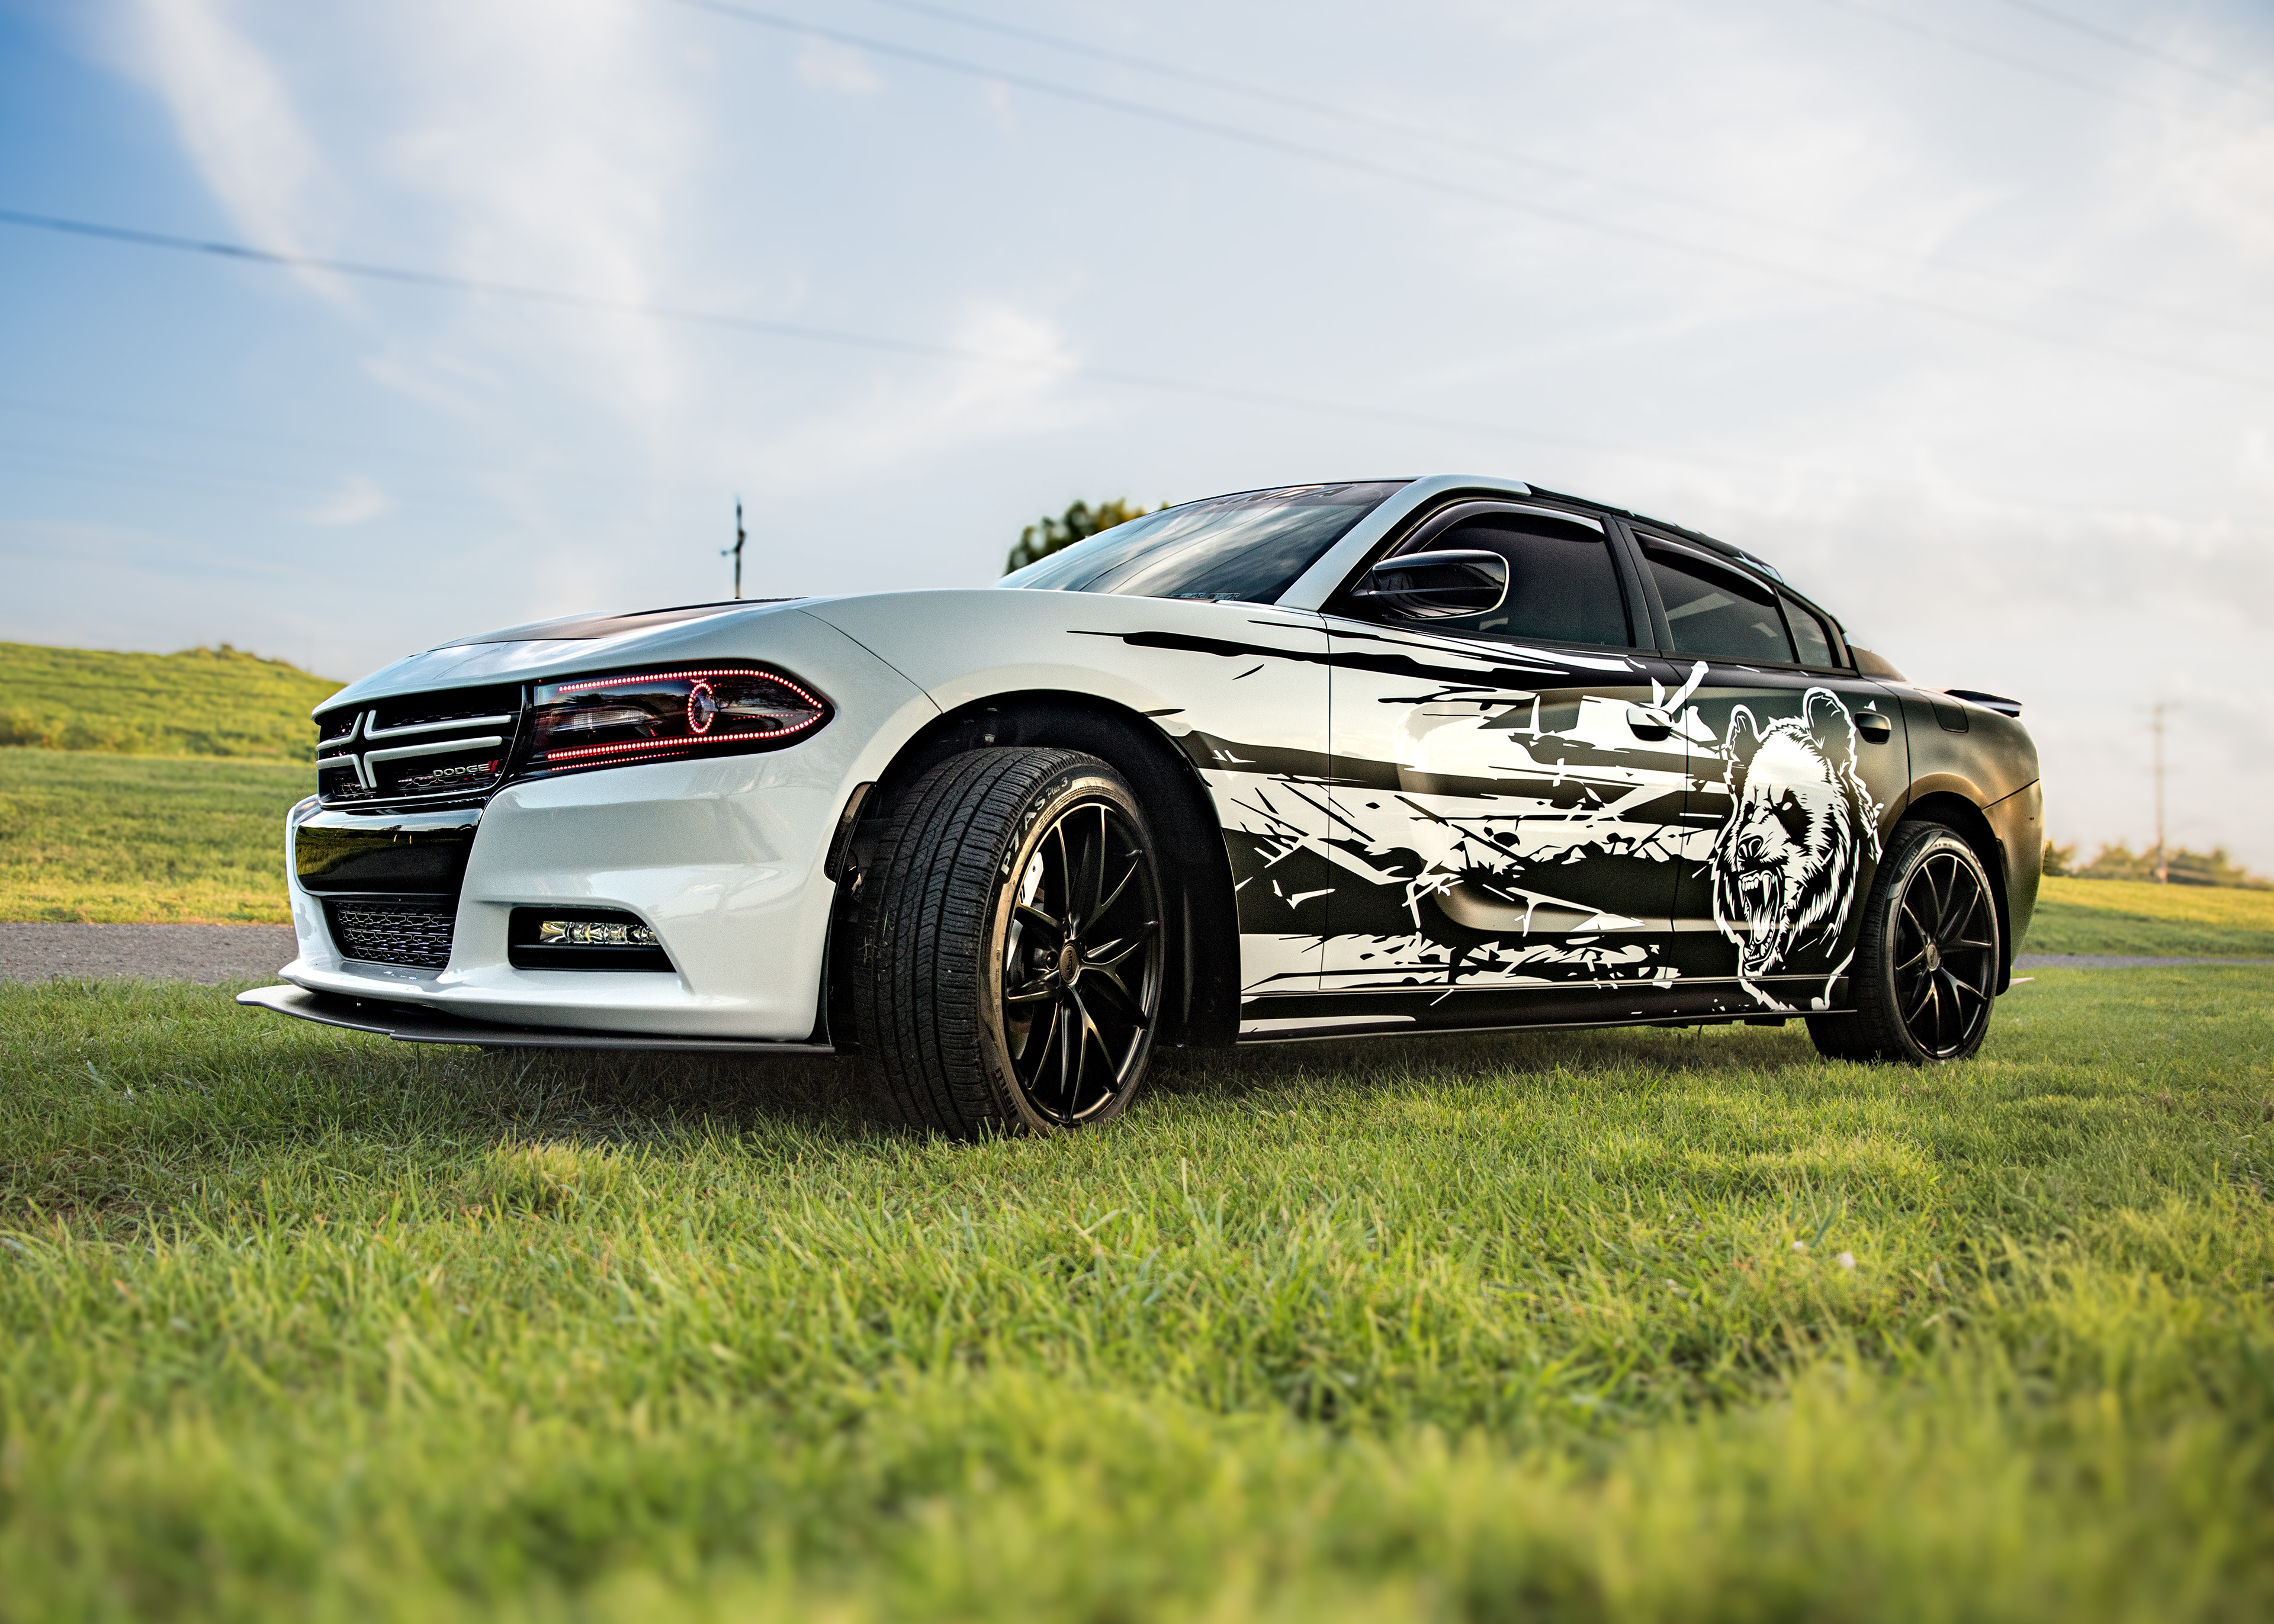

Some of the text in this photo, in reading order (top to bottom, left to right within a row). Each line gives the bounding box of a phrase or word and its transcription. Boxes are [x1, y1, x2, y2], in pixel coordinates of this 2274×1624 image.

[433, 764, 490, 777] DODGE
[1000, 829, 1019, 875] P7
[1046, 784, 1060, 799] Plus
[1061, 777, 1068, 787] 3
[1899, 847, 1919, 875] PIRELLI
[993, 1067, 1019, 1118] PIRELLI
